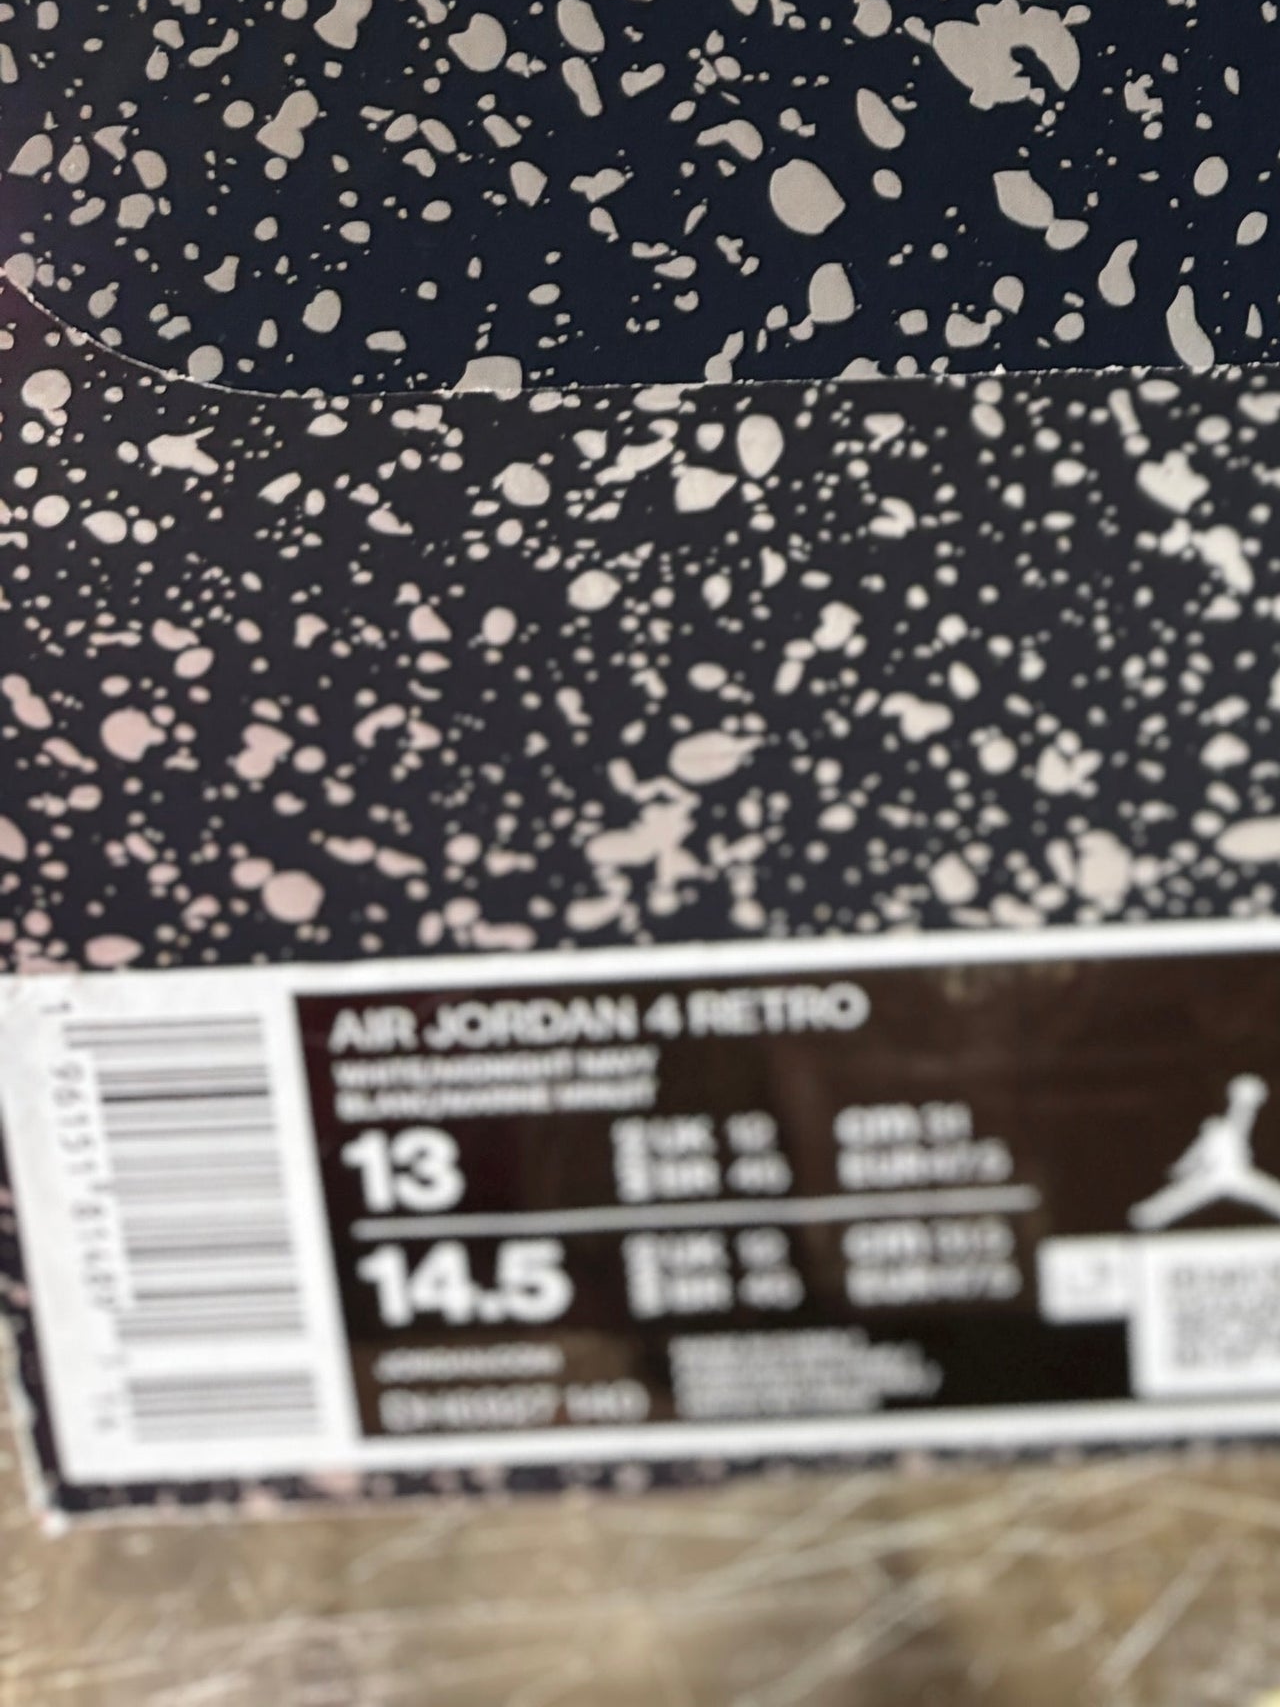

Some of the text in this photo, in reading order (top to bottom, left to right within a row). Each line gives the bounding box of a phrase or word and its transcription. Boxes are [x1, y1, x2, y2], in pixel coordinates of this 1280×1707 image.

[328, 982, 869, 1052] AIR JORDAN 4 RETRO
[342, 1125, 464, 1212] 13
[356, 1238, 573, 1325] 14.5
